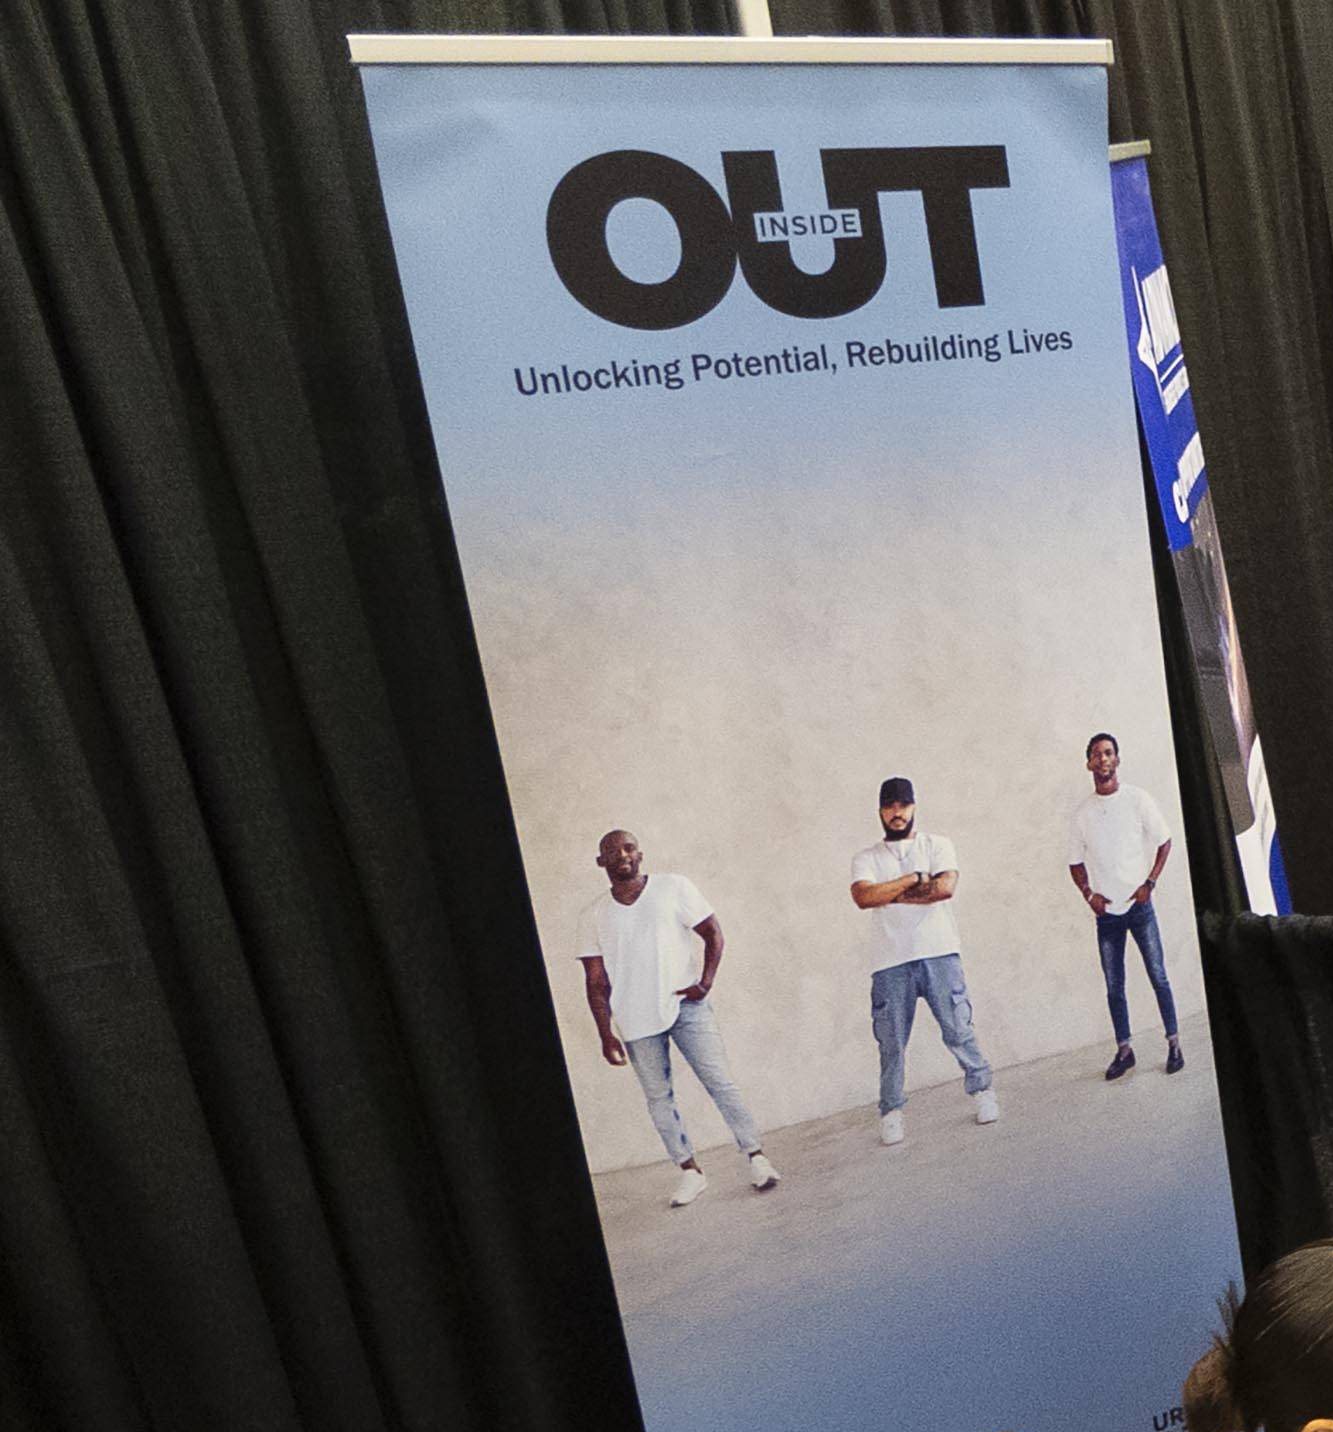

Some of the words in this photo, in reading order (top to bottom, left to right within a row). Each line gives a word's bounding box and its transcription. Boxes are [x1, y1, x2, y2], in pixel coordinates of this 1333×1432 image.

[546, 145, 1011, 331] OUT
[759, 214, 857, 238] INSIDE
[514, 360, 684, 395] Unlocking
[692, 344, 836, 380] Potential,
[846, 334, 1001, 367] Rebuilding
[1008, 329, 1072, 354] Lives
